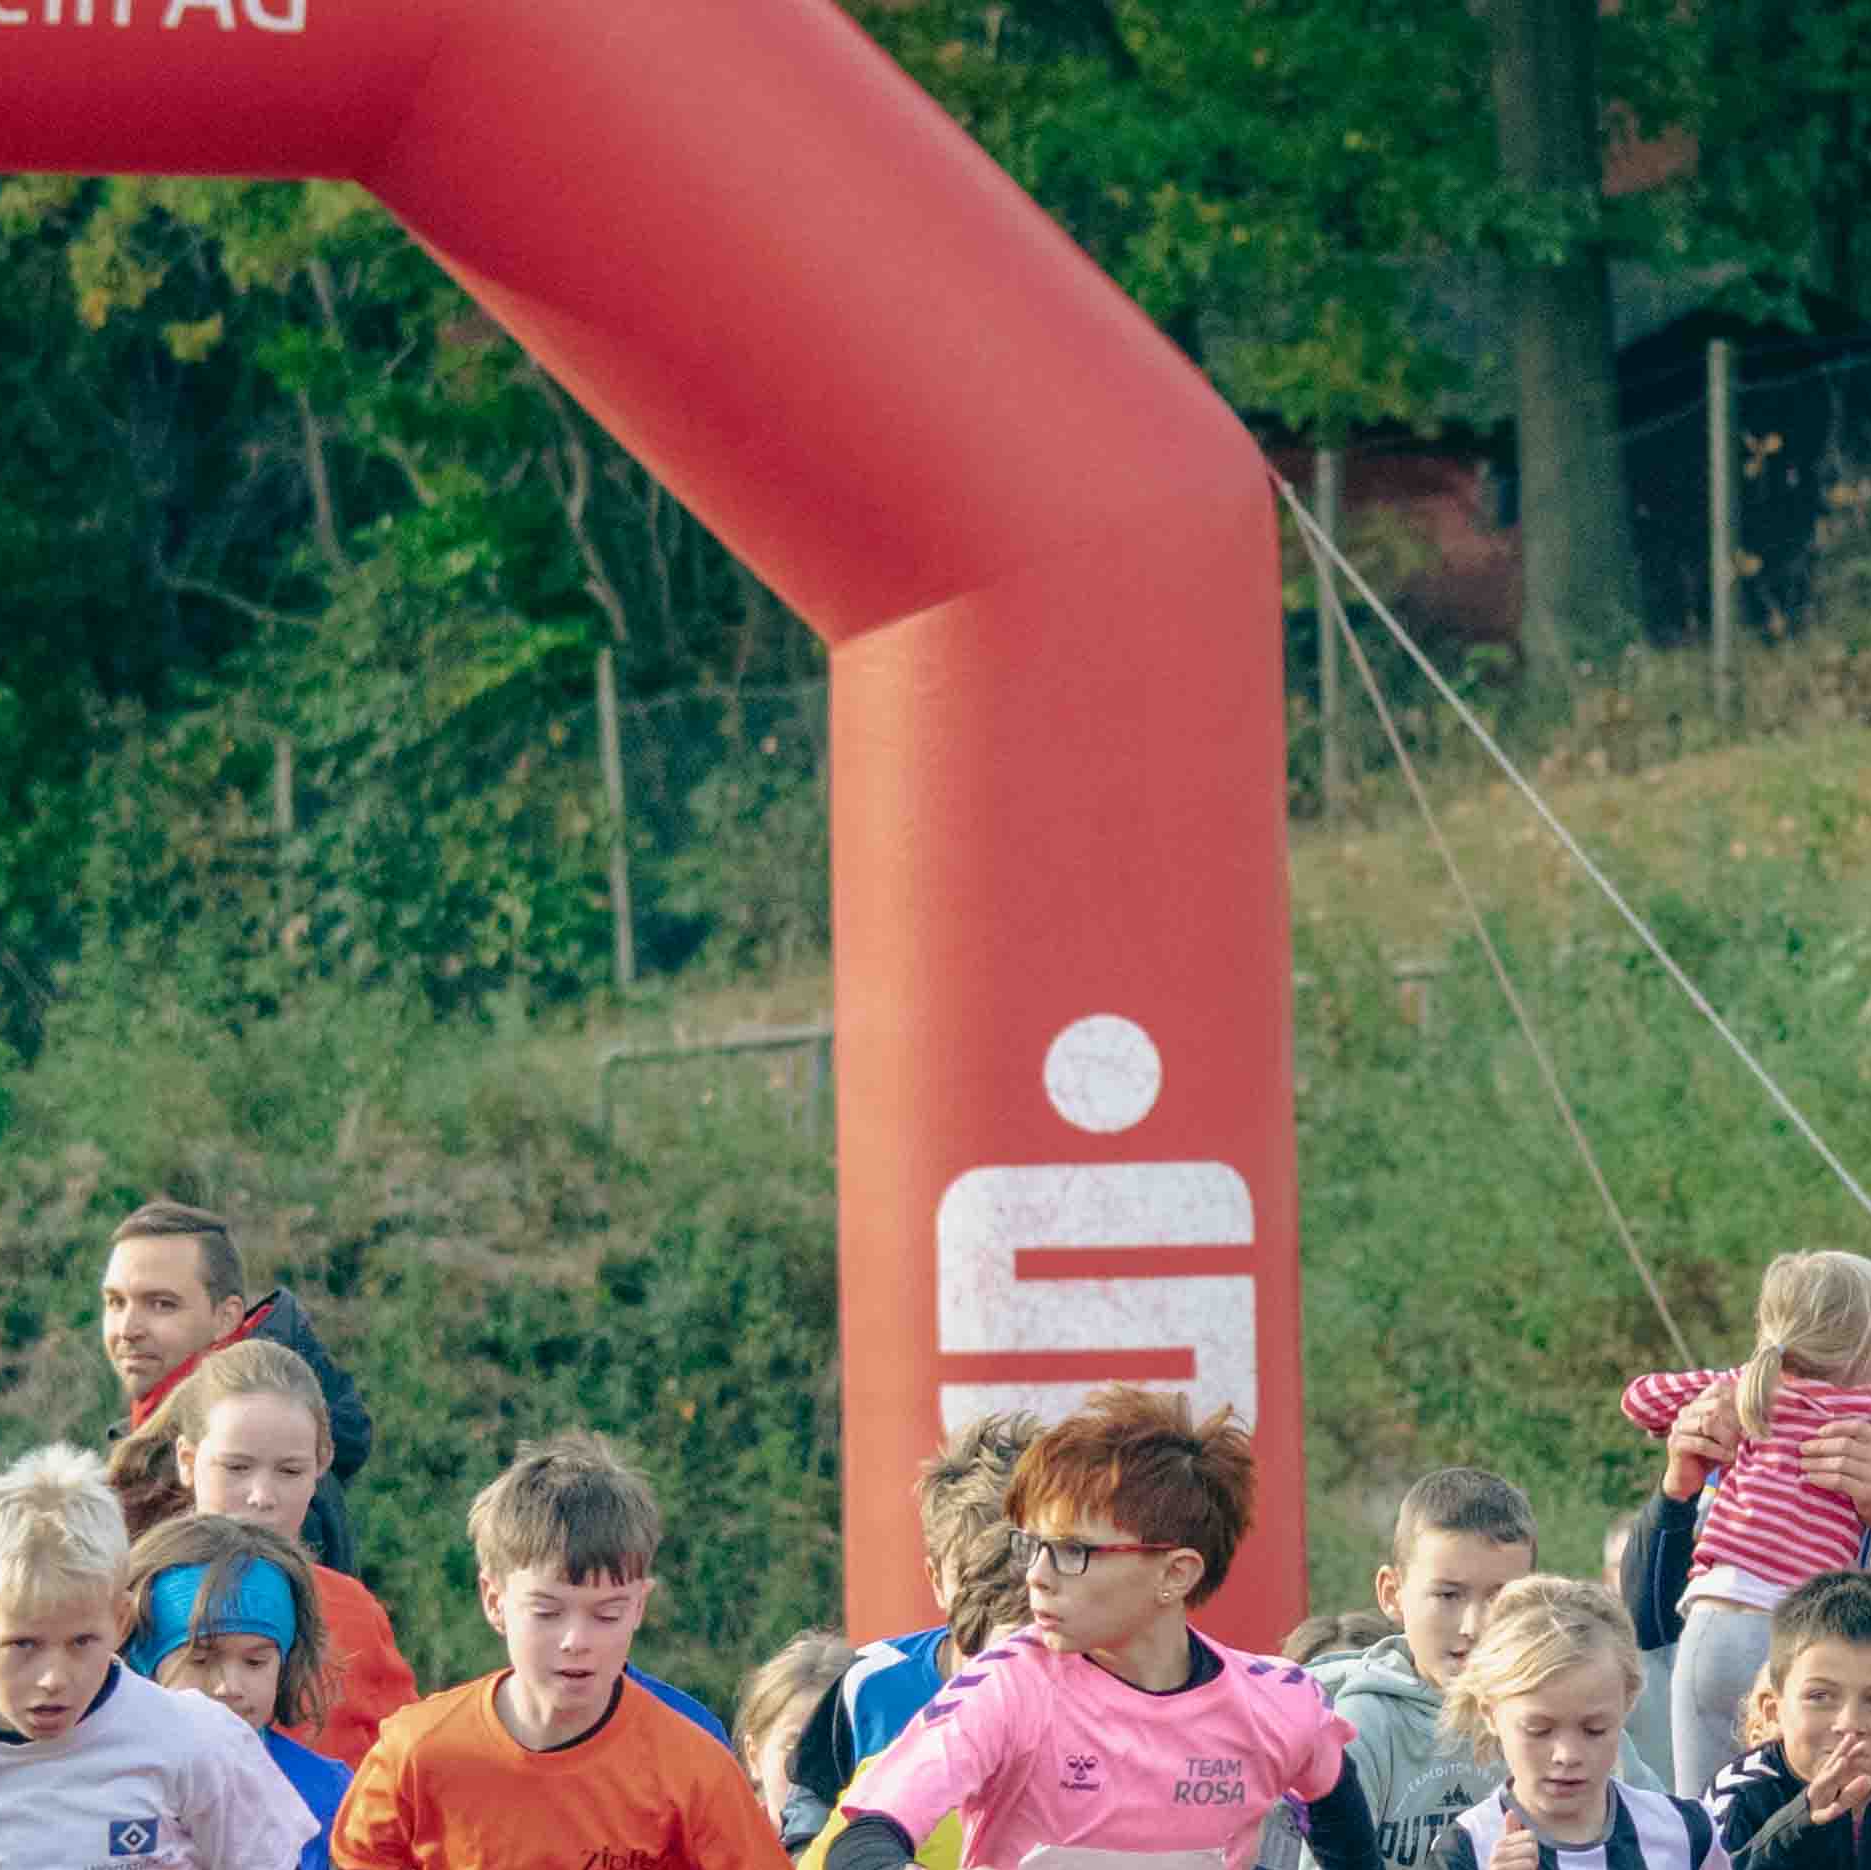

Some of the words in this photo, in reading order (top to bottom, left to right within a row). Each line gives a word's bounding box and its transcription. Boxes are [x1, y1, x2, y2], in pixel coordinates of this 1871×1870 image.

[1186, 1758, 1242, 1777] TEAM
[1174, 1780, 1246, 1806] ROSA
[1379, 1811, 1458, 1867] OUT
